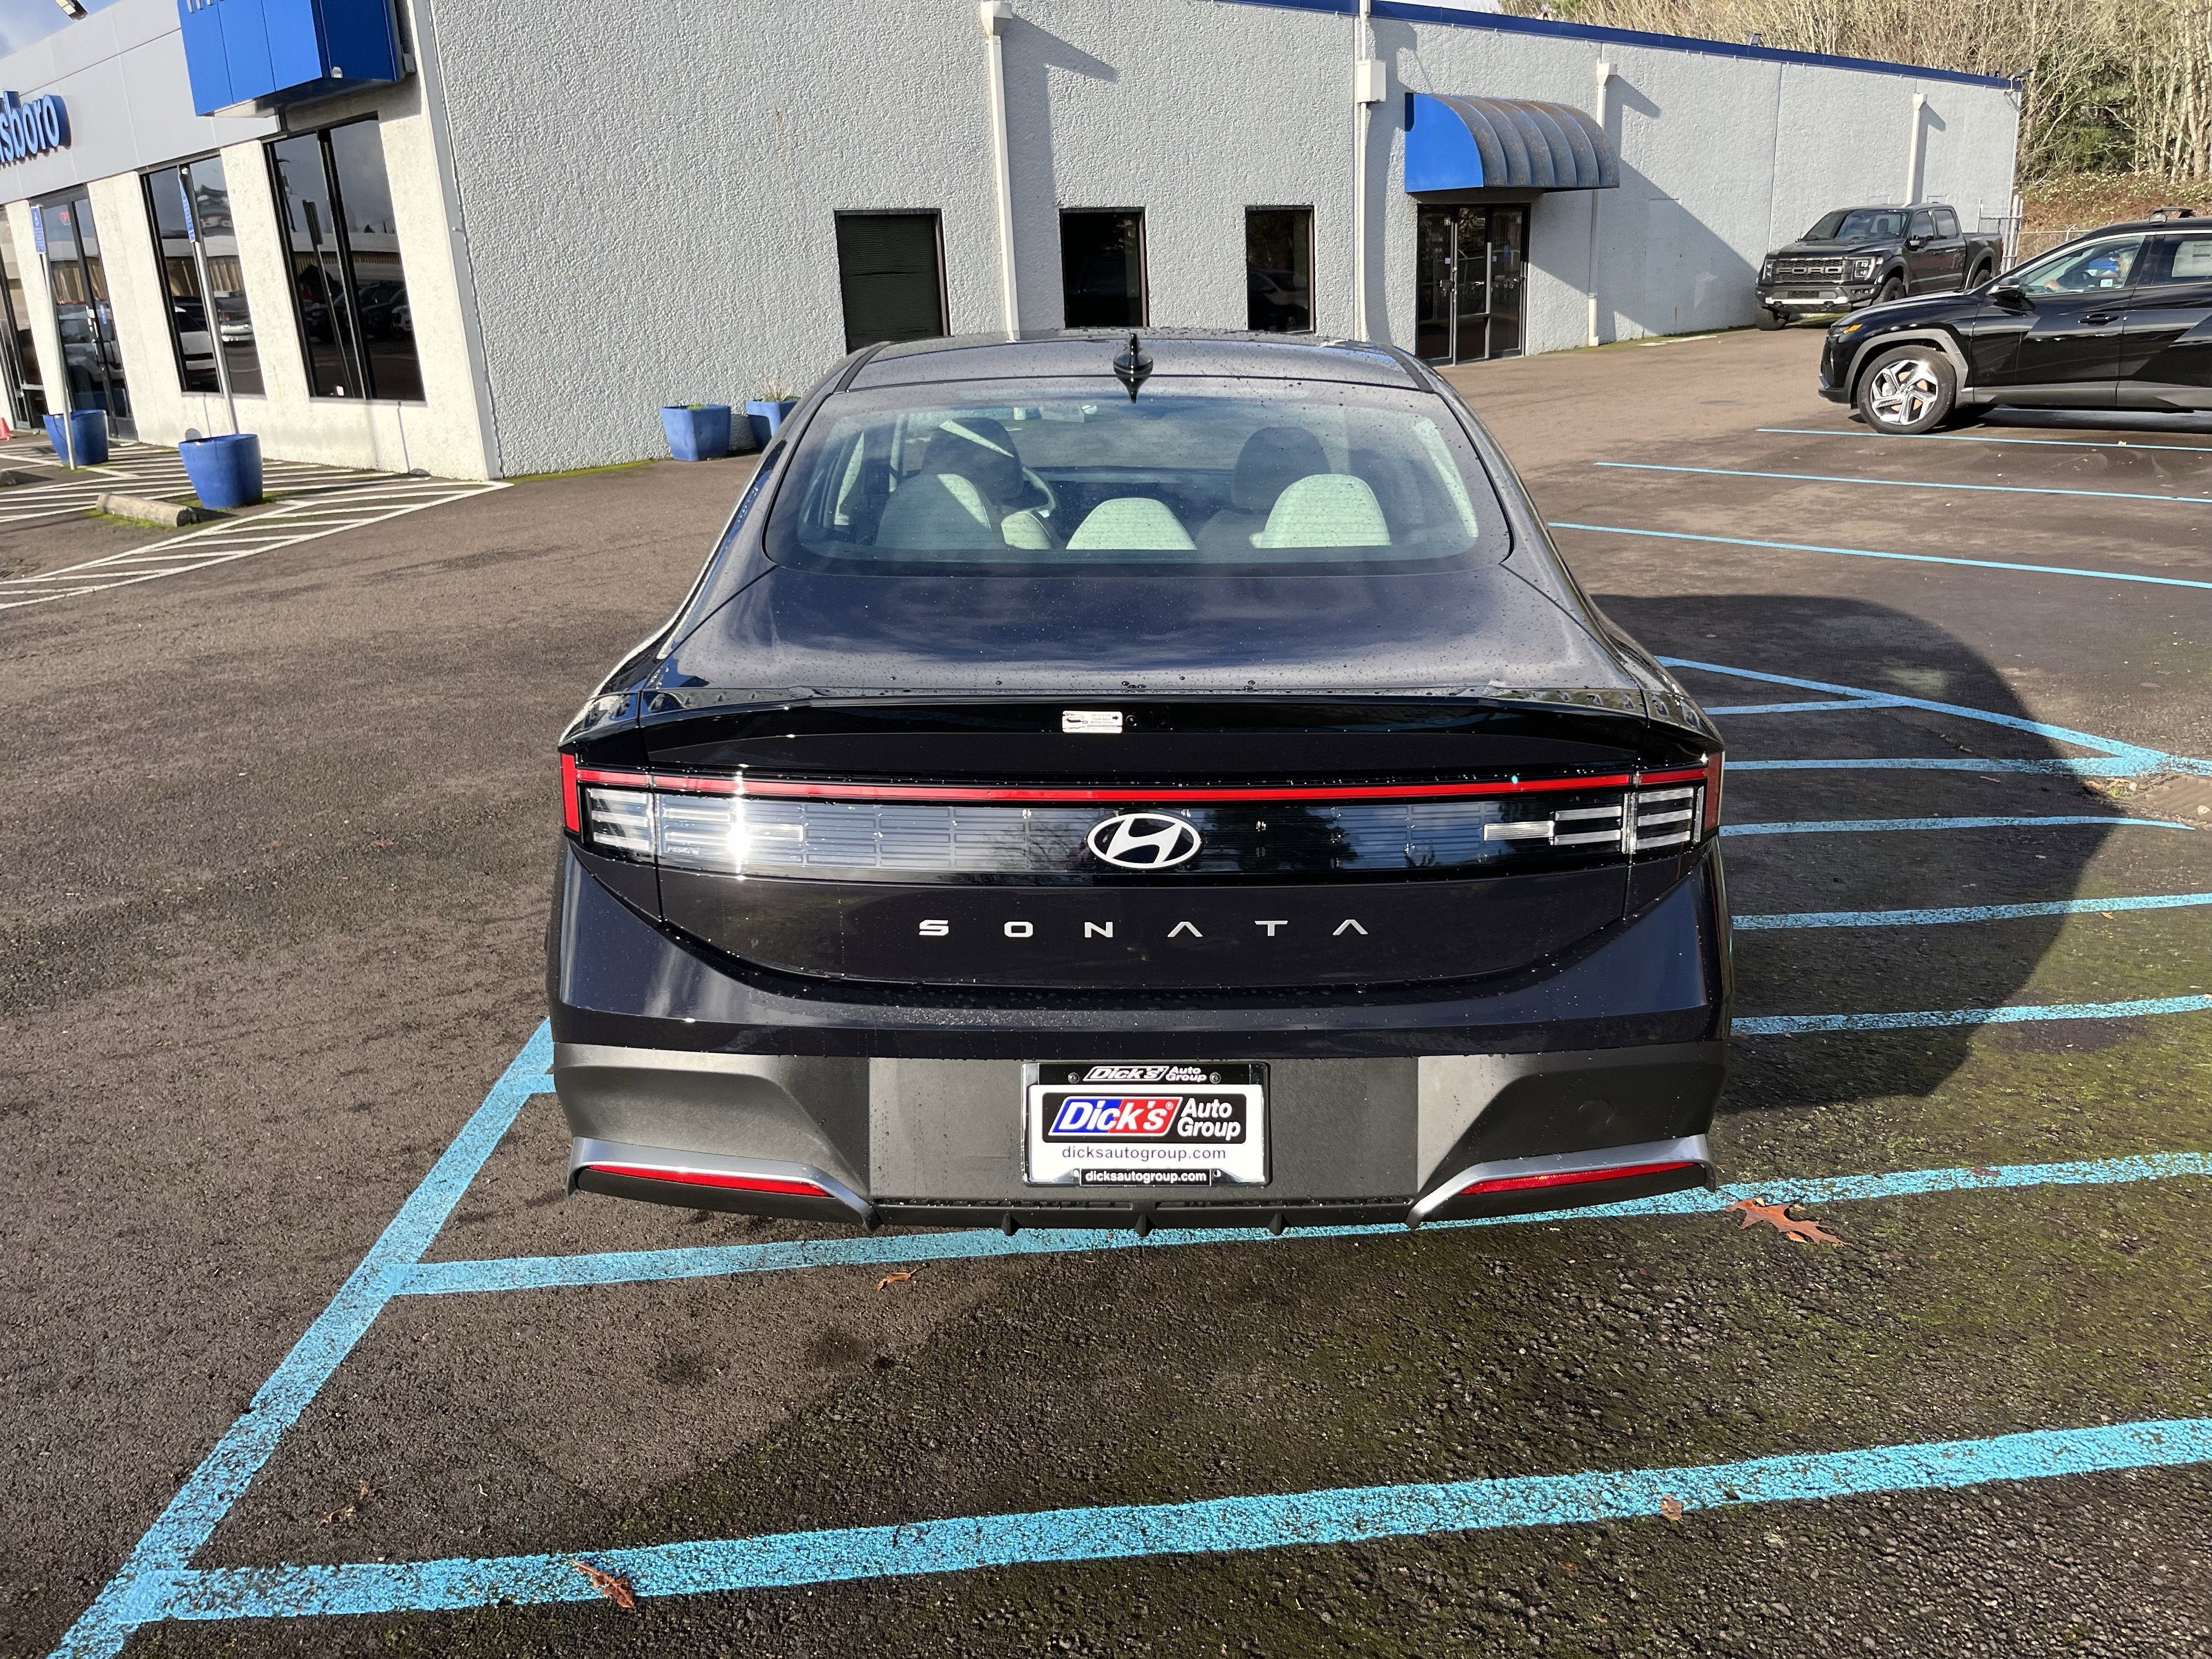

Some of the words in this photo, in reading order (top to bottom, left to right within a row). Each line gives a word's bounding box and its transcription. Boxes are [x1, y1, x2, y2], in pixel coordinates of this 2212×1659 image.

[918, 919, 1369, 938] SONATA
[1090, 1067, 1161, 1079] Dick's
[1169, 1066, 1201, 1074] Auto
[1165, 1074, 1207, 1082] Group
[1180, 1097, 1233, 1118] Auto
[1177, 1116, 1242, 1141] Group
[1062, 1146, 1226, 1161] dicksautogroup.com
[1085, 1170, 1207, 1184] dicksautogroup.com
